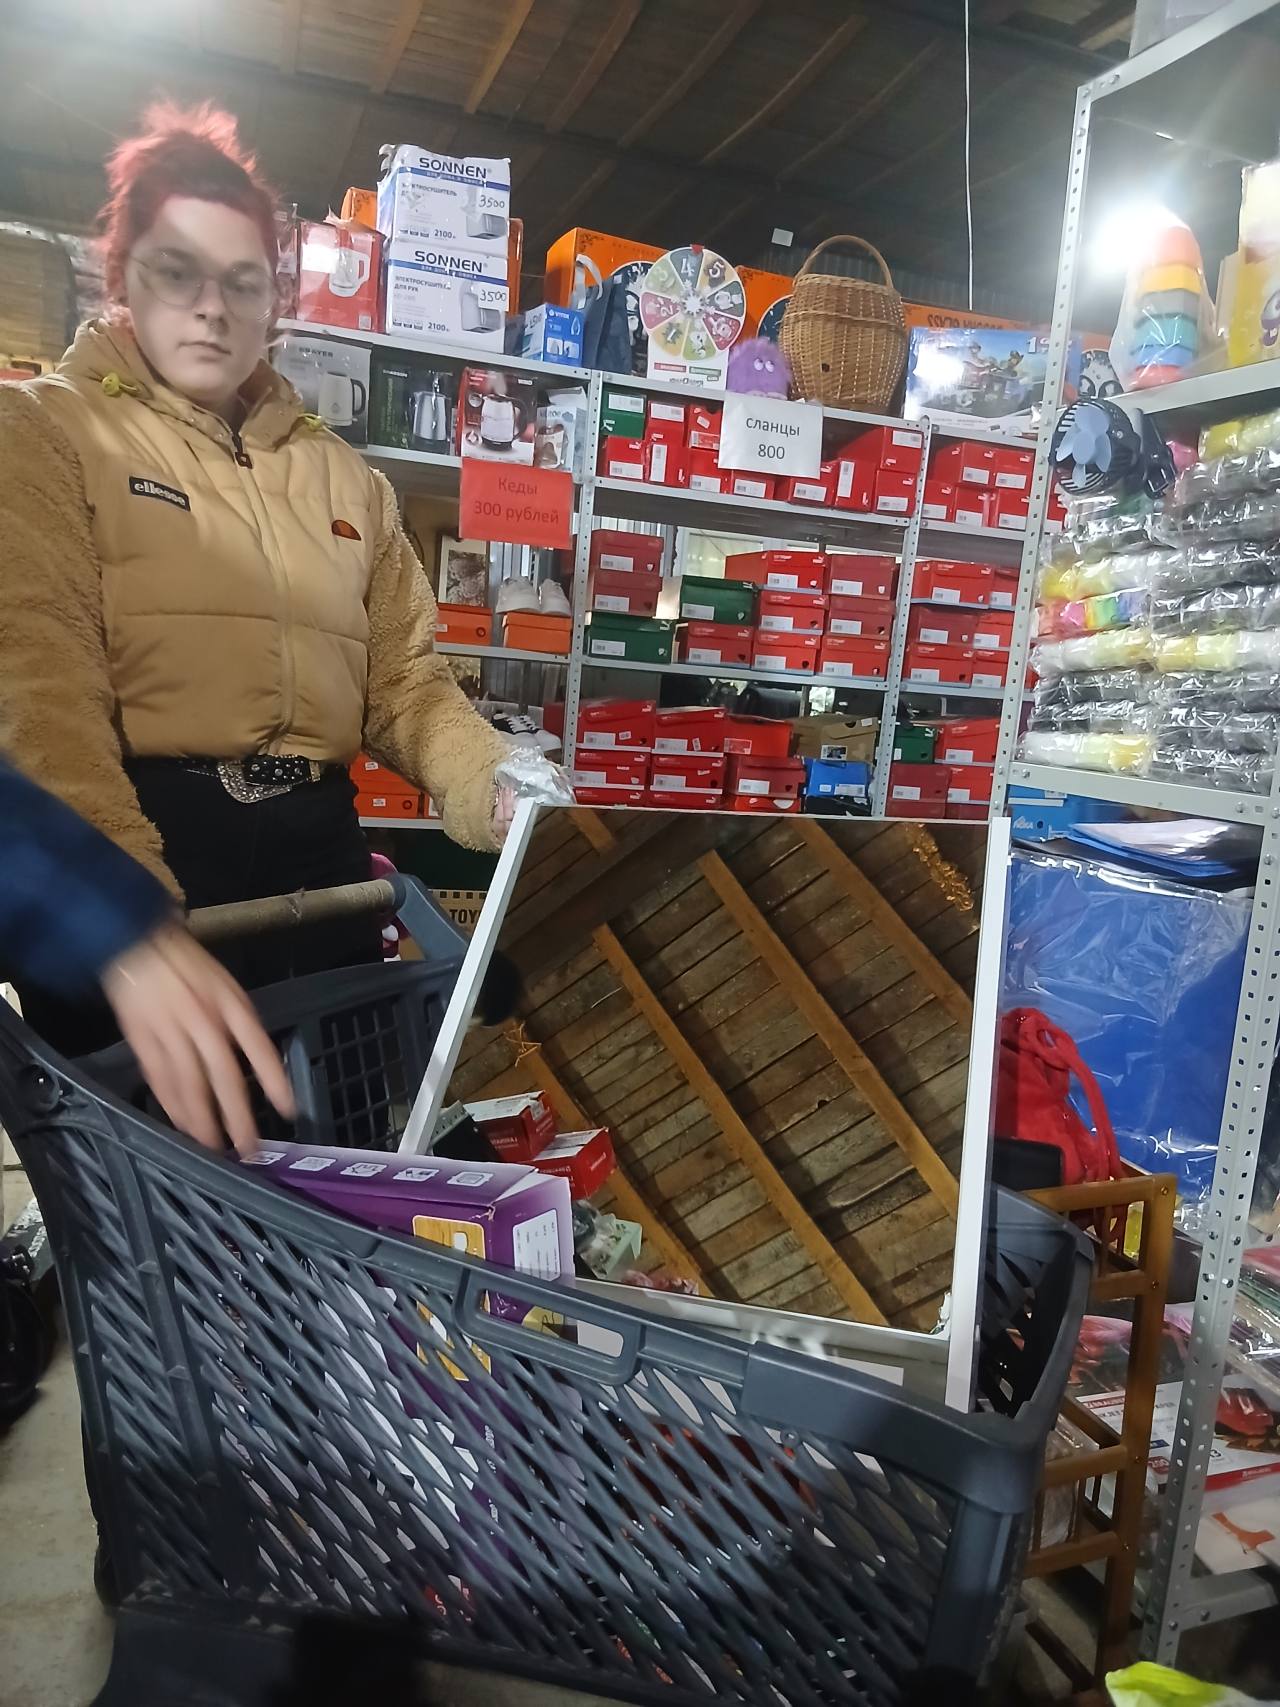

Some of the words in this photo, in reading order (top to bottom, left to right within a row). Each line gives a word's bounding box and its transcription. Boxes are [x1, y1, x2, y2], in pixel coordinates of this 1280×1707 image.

[419, 157, 487, 179] SONNEN
[479, 194, 506, 209] 3500
[434, 228, 453, 239] 2100
[414, 250, 483, 273] SONNEN
[479, 289, 507, 302] 3500
[427, 321, 447, 332] 2100
[745, 417, 800, 438] сланцы
[757, 443, 785, 460] 800
[498, 477, 538, 497] Кеды
[474, 500, 502, 517] 300
[505, 506, 560, 525] рублей
